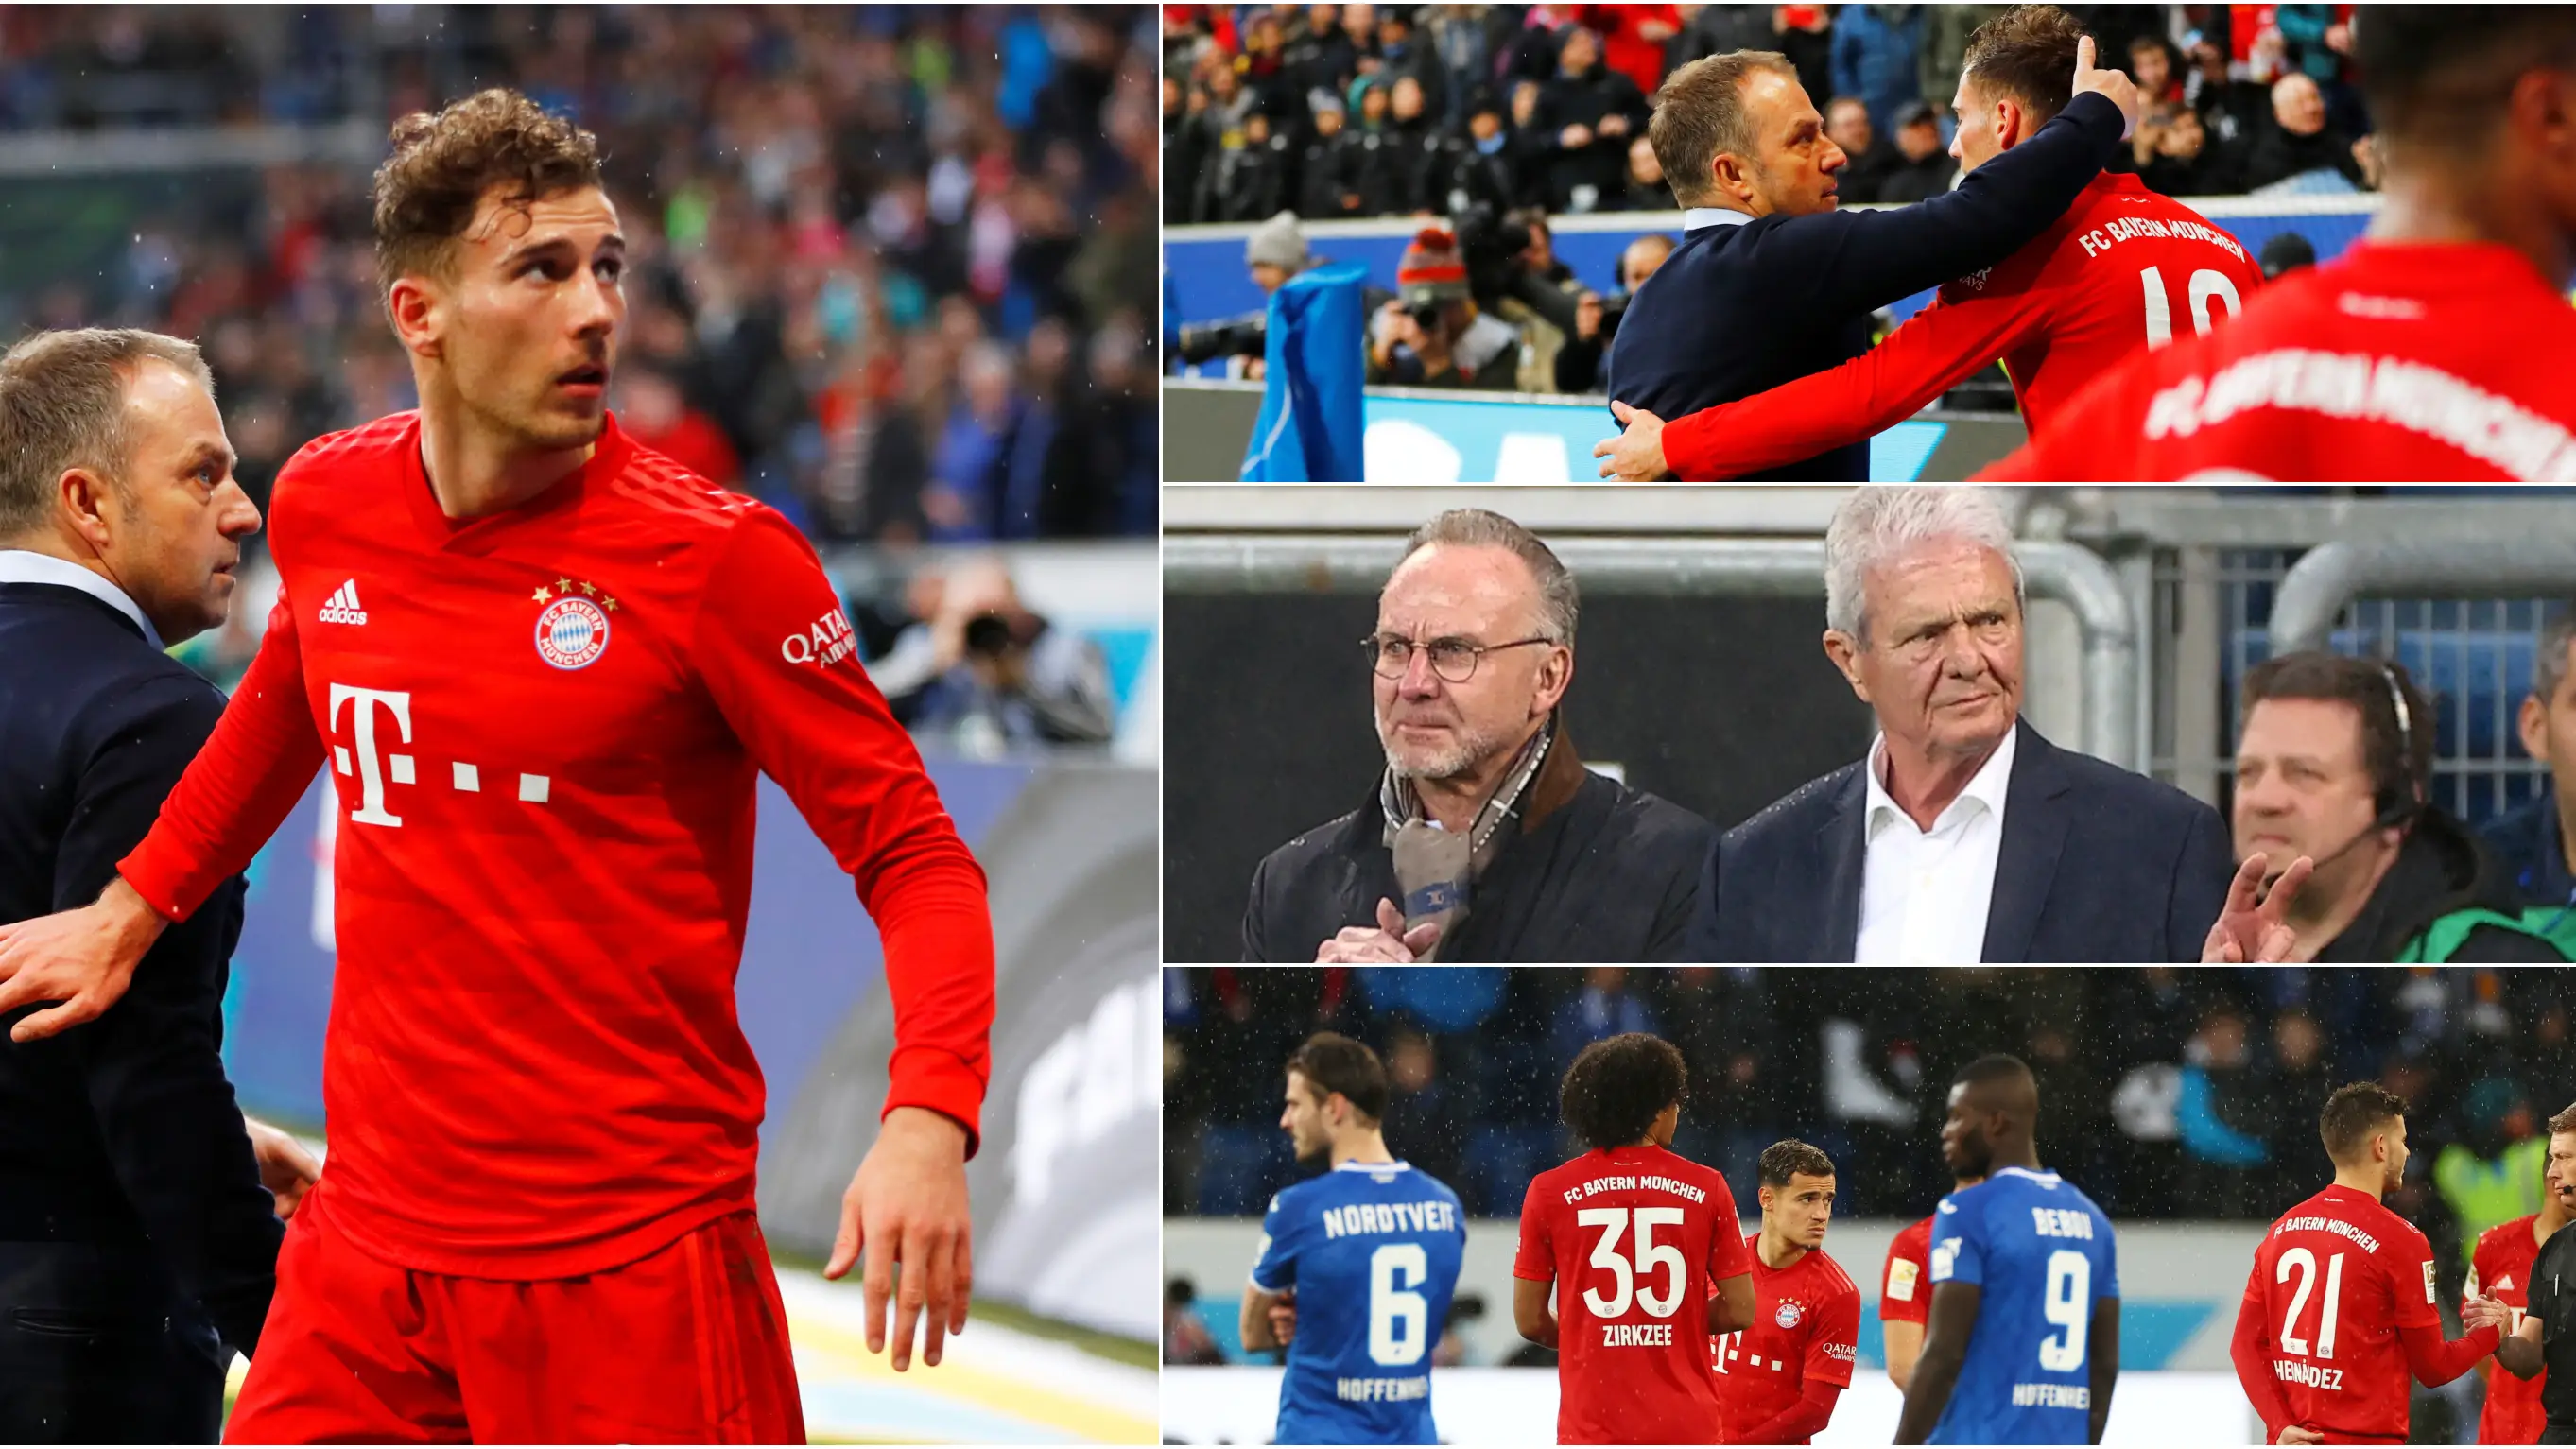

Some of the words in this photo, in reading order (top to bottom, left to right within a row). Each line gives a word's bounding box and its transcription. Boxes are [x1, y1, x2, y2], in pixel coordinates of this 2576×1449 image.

[2078, 230, 2111, 258] FC
[2104, 216, 2172, 243] BAYERN
[319, 606, 368, 626] adidas
[543, 610, 561, 627] FC
[560, 602, 604, 631] BAYERN
[782, 608, 853, 664] QATA
[329, 681, 412, 827] T
[1563, 1186, 1583, 1205] FC
[1582, 1175, 1637, 1197] BAYERN
[1323, 1200, 1455, 1239] NORDTVEIT
[2273, 1222, 2285, 1240] FC
[2285, 1216, 2327, 1232] BAYERN
[1577, 1207, 1687, 1319] 35
[1369, 1243, 1427, 1367] 6
[2038, 1249, 2091, 1372] 9
[2276, 1247, 2345, 1359] 21
[1602, 1325, 1672, 1347] ZIRKZEE
[1822, 1342, 1857, 1355] QATAR
